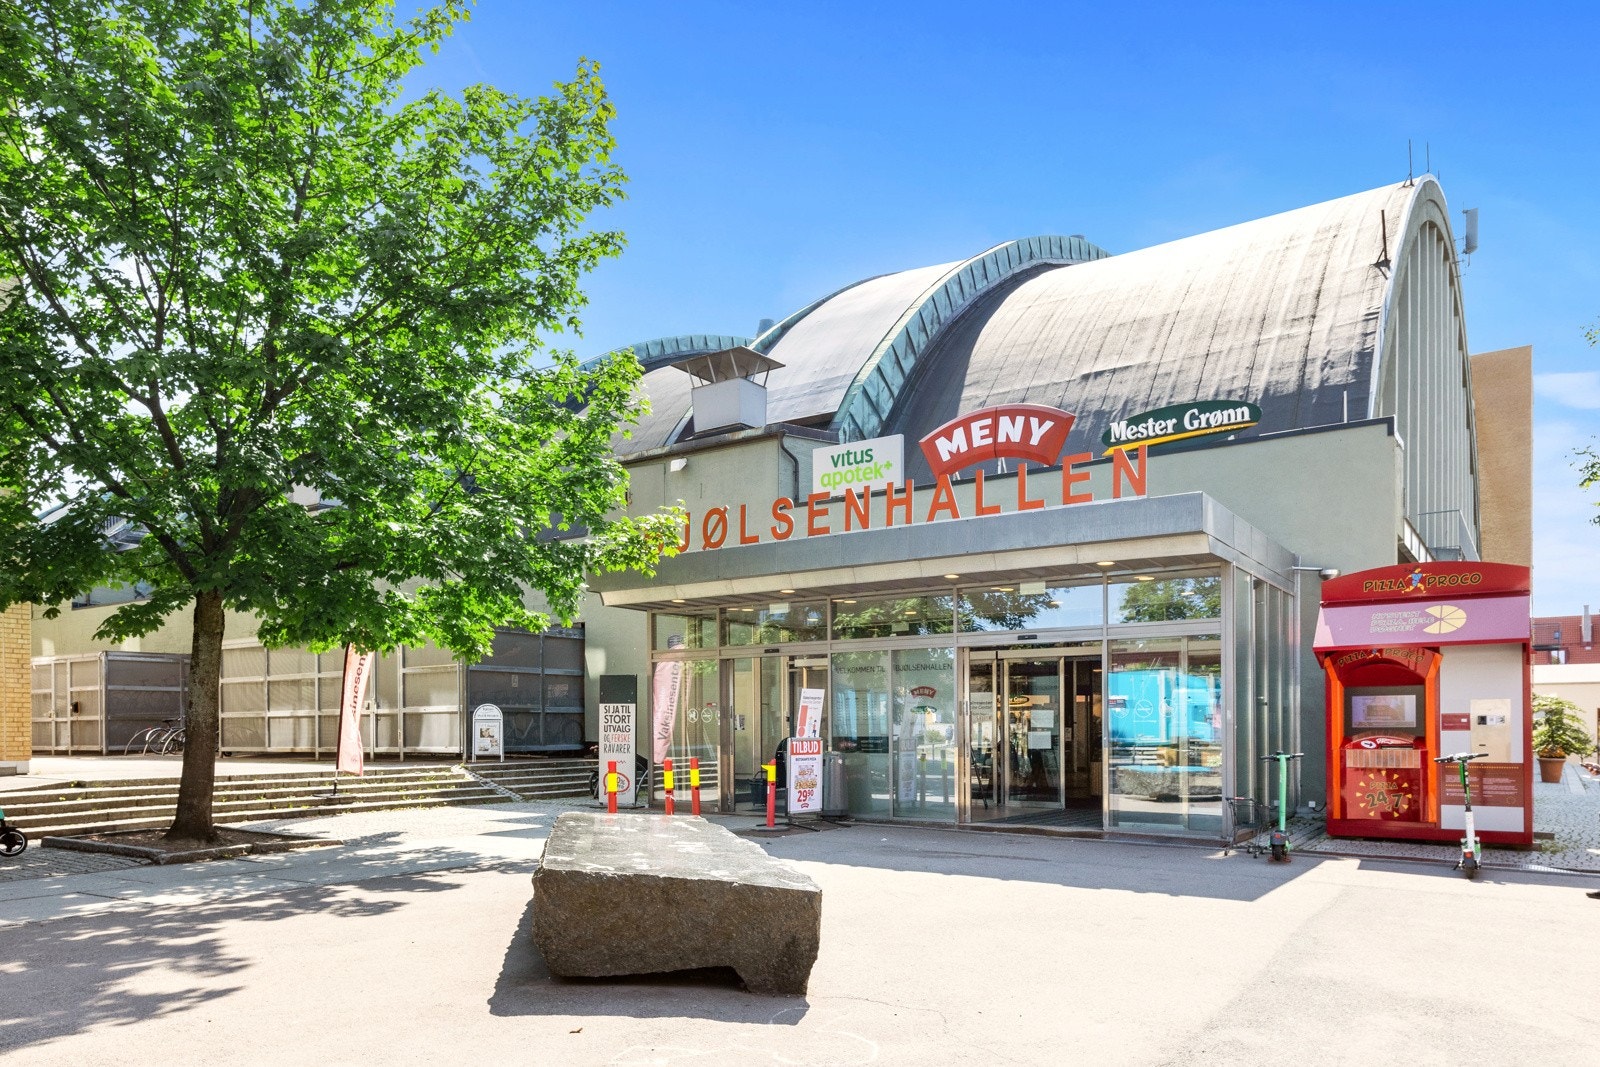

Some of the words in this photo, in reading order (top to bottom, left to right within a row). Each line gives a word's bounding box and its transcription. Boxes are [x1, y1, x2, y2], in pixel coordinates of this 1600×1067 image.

[1109, 417, 1178, 443] Mester
[1183, 405, 1251, 431] Grønn
[934, 415, 1055, 462] MENY
[830, 448, 874, 468] vitus
[643, 444, 1149, 554] JØLSENHALLEN
[1363, 577, 1407, 593] PIZZA
[1426, 572, 1483, 588] PROCO
[1338, 650, 1367, 668] PIZZA
[1384, 647, 1425, 664] PROCO
[877, 665, 885, 673] TIL
[913, 687, 934, 696] MENY
[603, 705, 611, 714] SI
[611, 705, 620, 714] JA
[620, 705, 631, 714] TIL
[656, 661, 680, 741] Vaksinesente
[603, 714, 631, 724] STORT
[603, 724, 631, 733] UTVALG
[611, 733, 631, 743] FERSKE
[792, 740, 819, 754] TILBUD
